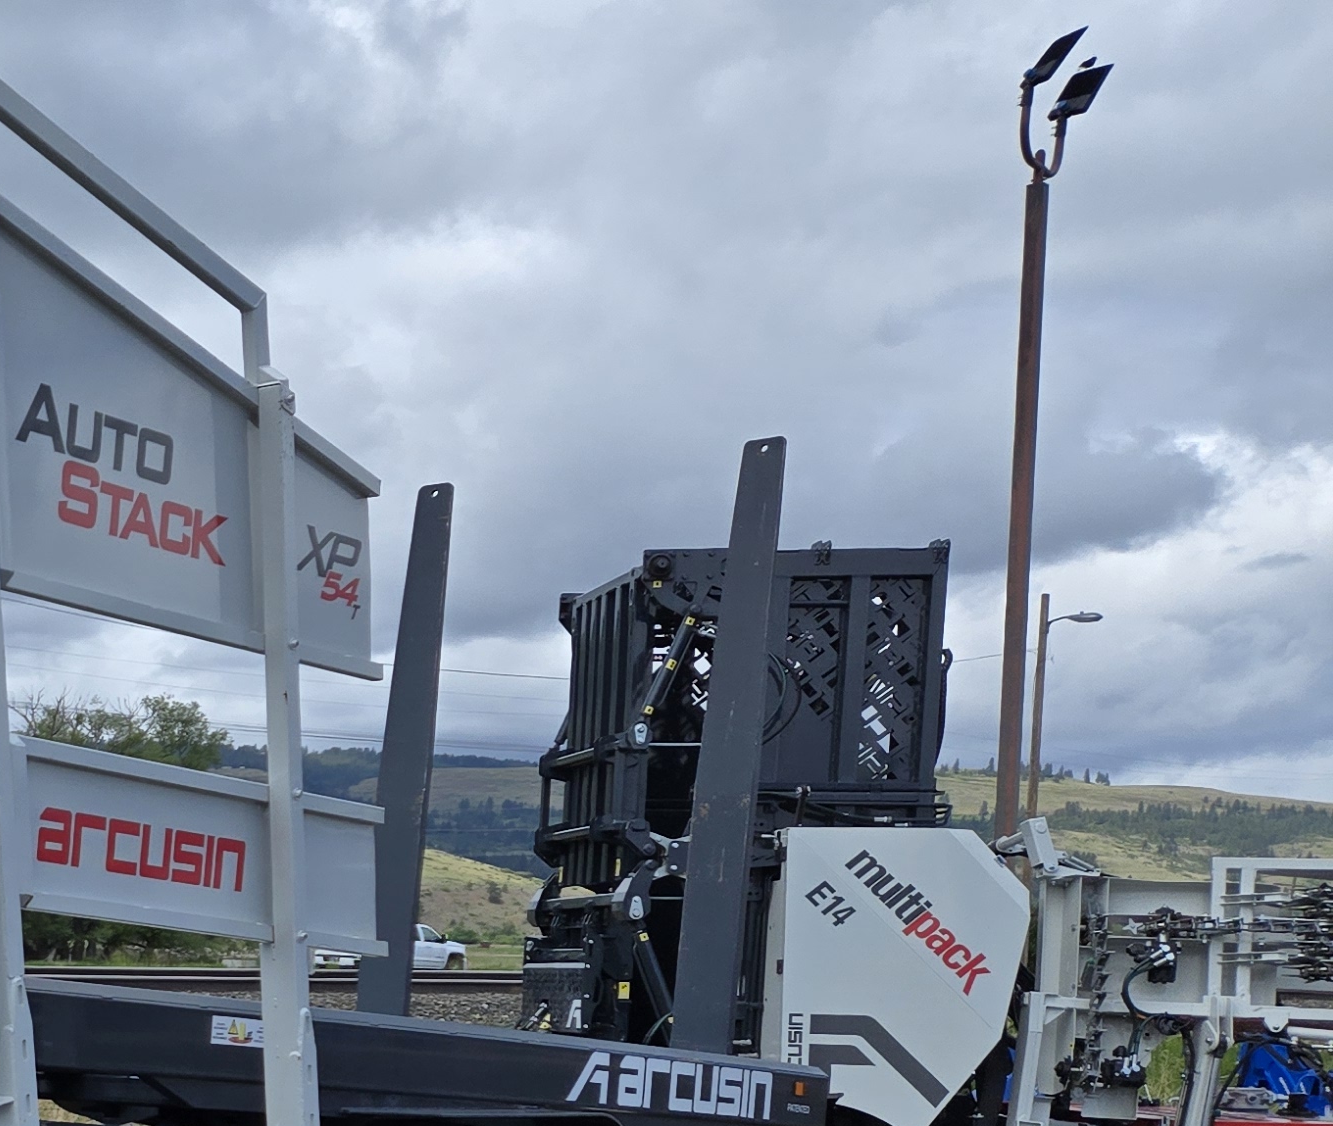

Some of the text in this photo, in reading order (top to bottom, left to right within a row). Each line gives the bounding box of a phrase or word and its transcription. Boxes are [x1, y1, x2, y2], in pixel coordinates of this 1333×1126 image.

[15, 383, 174, 485] AUTO
[58, 460, 229, 567] STACK
[296, 524, 362, 577] XP
[36, 806, 246, 892] arcusin
[804, 880, 857, 927] E14
[844, 849, 991, 996] multipack
[617, 1054, 773, 1121] arcusin
